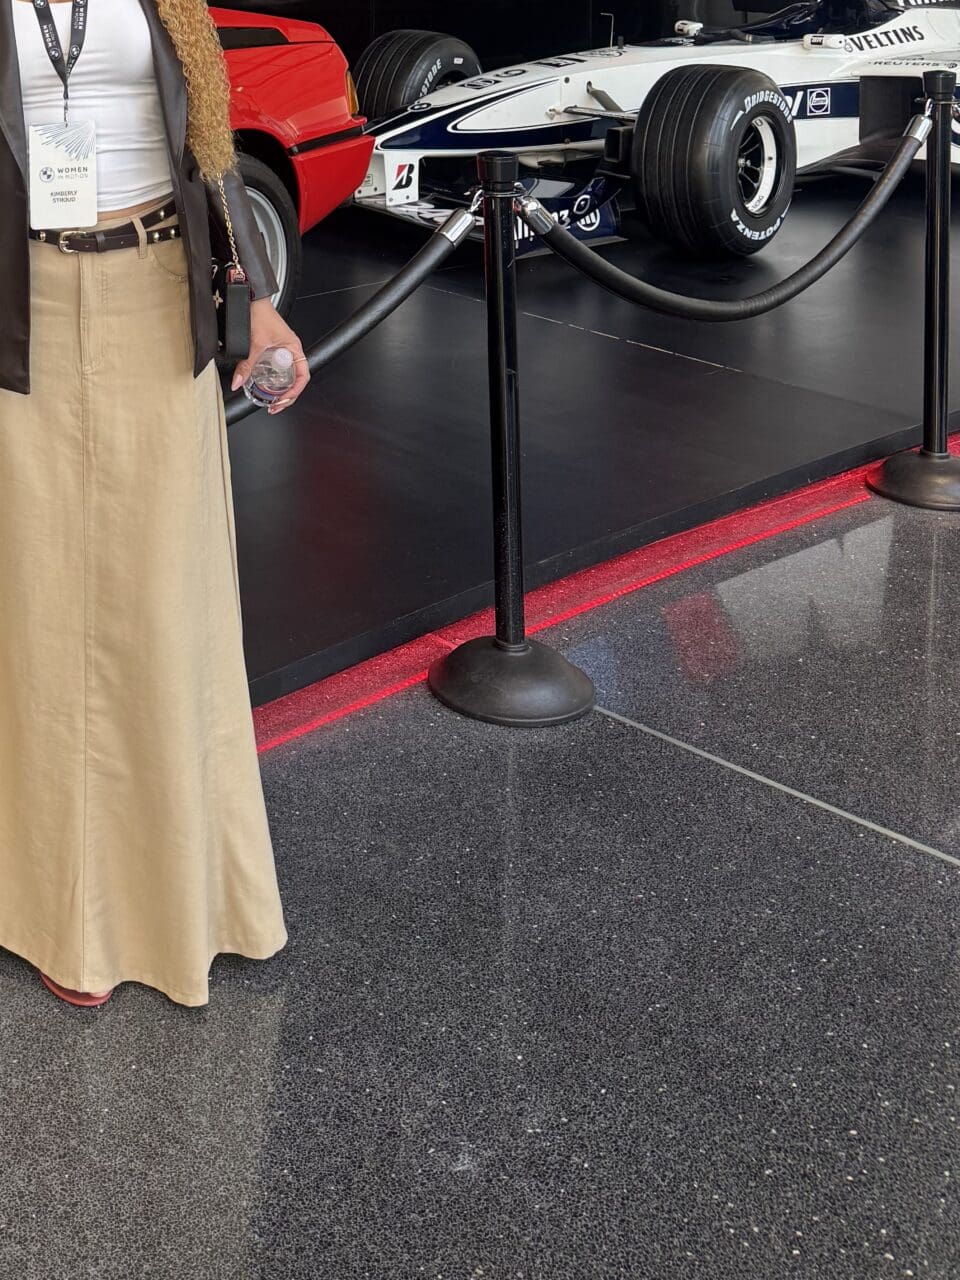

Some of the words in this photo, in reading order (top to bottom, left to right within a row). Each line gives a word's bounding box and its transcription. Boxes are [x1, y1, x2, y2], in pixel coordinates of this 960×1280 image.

[850, 25, 925, 52] VELTINS
[57, 166, 88, 174] WOMEN
[731, 208, 781, 241] POTENZA
